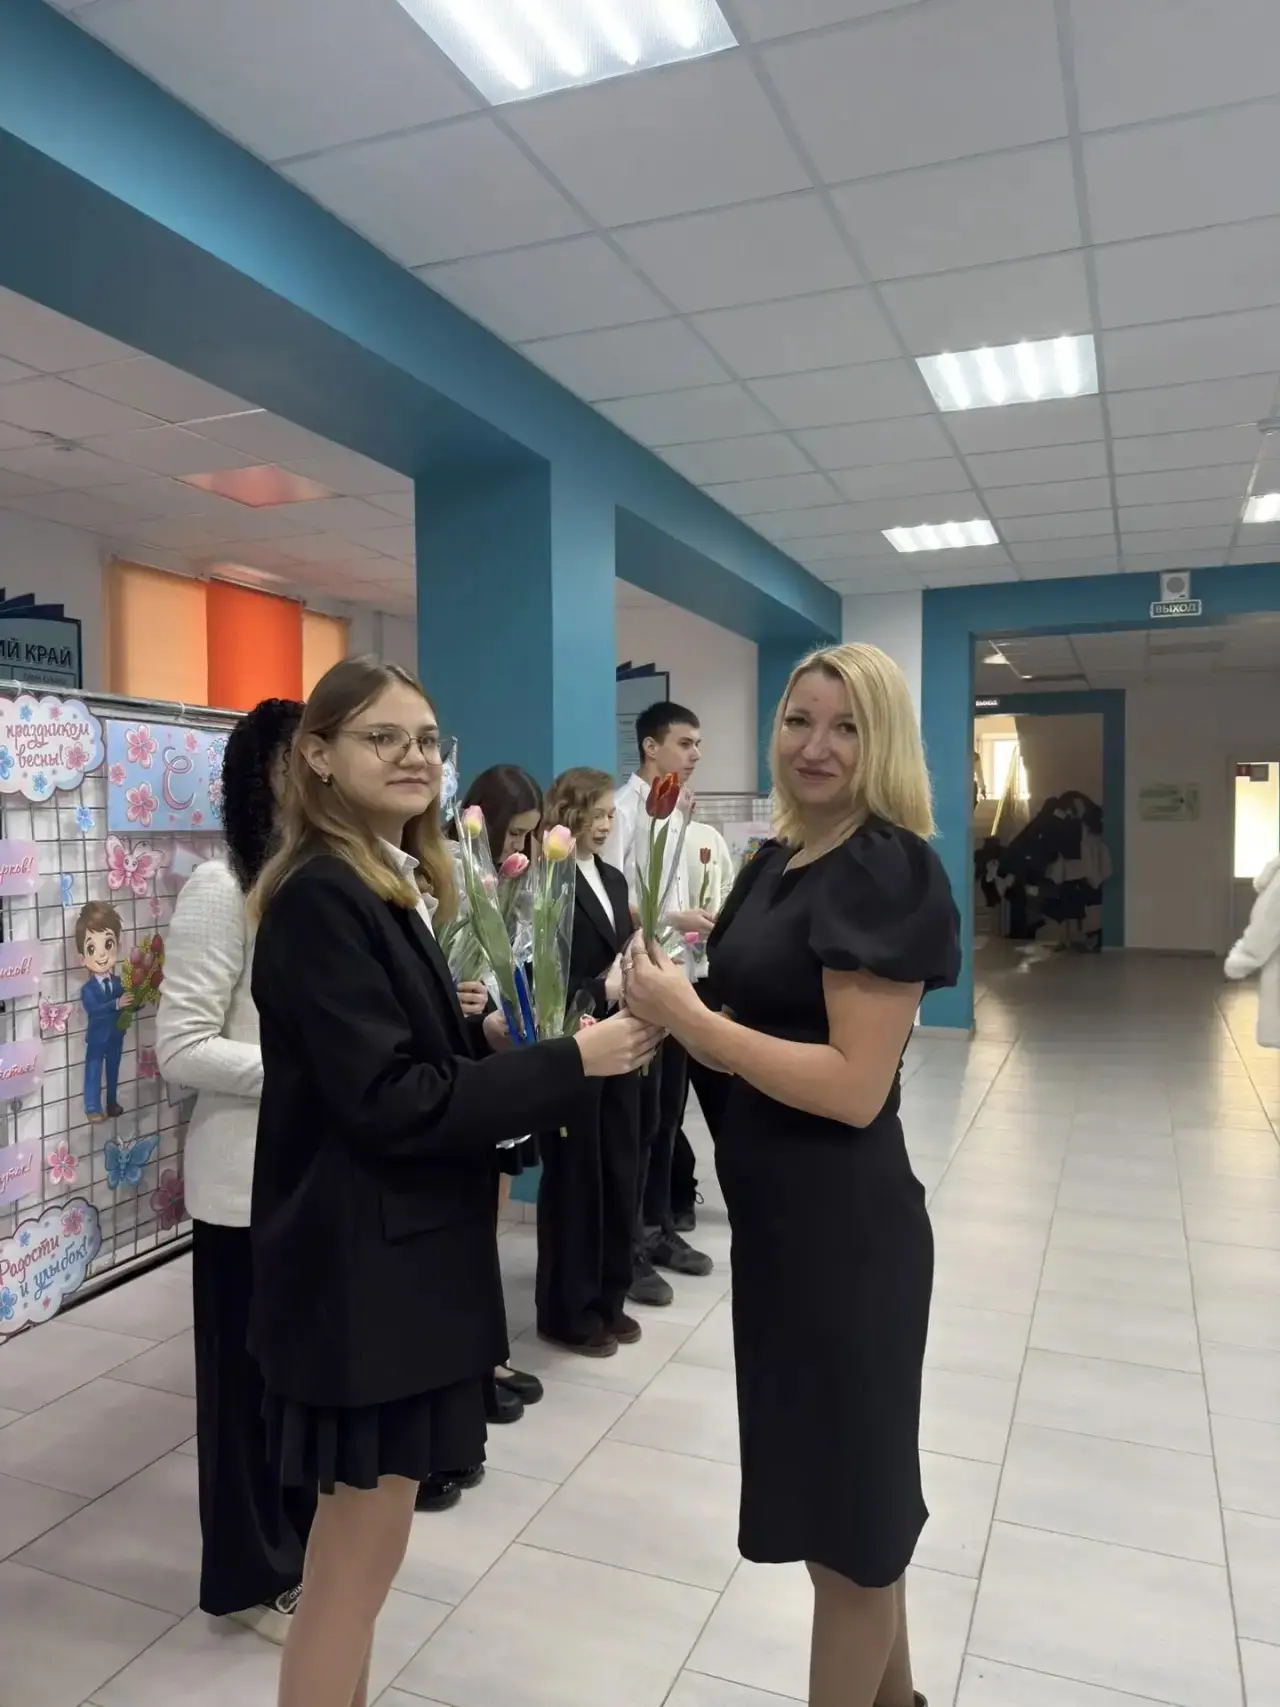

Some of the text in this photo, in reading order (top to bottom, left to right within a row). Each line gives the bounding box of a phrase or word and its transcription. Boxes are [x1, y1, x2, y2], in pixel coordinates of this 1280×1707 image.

[1156, 603, 1197, 614] ВЫХОД
[25, 643, 72, 666] КРАЙ
[6, 723, 90, 750] праздником
[16, 744, 64, 768] весны!
[0, 1236, 60, 1286] Радости
[20, 1236, 88, 1301] и улыбок!
